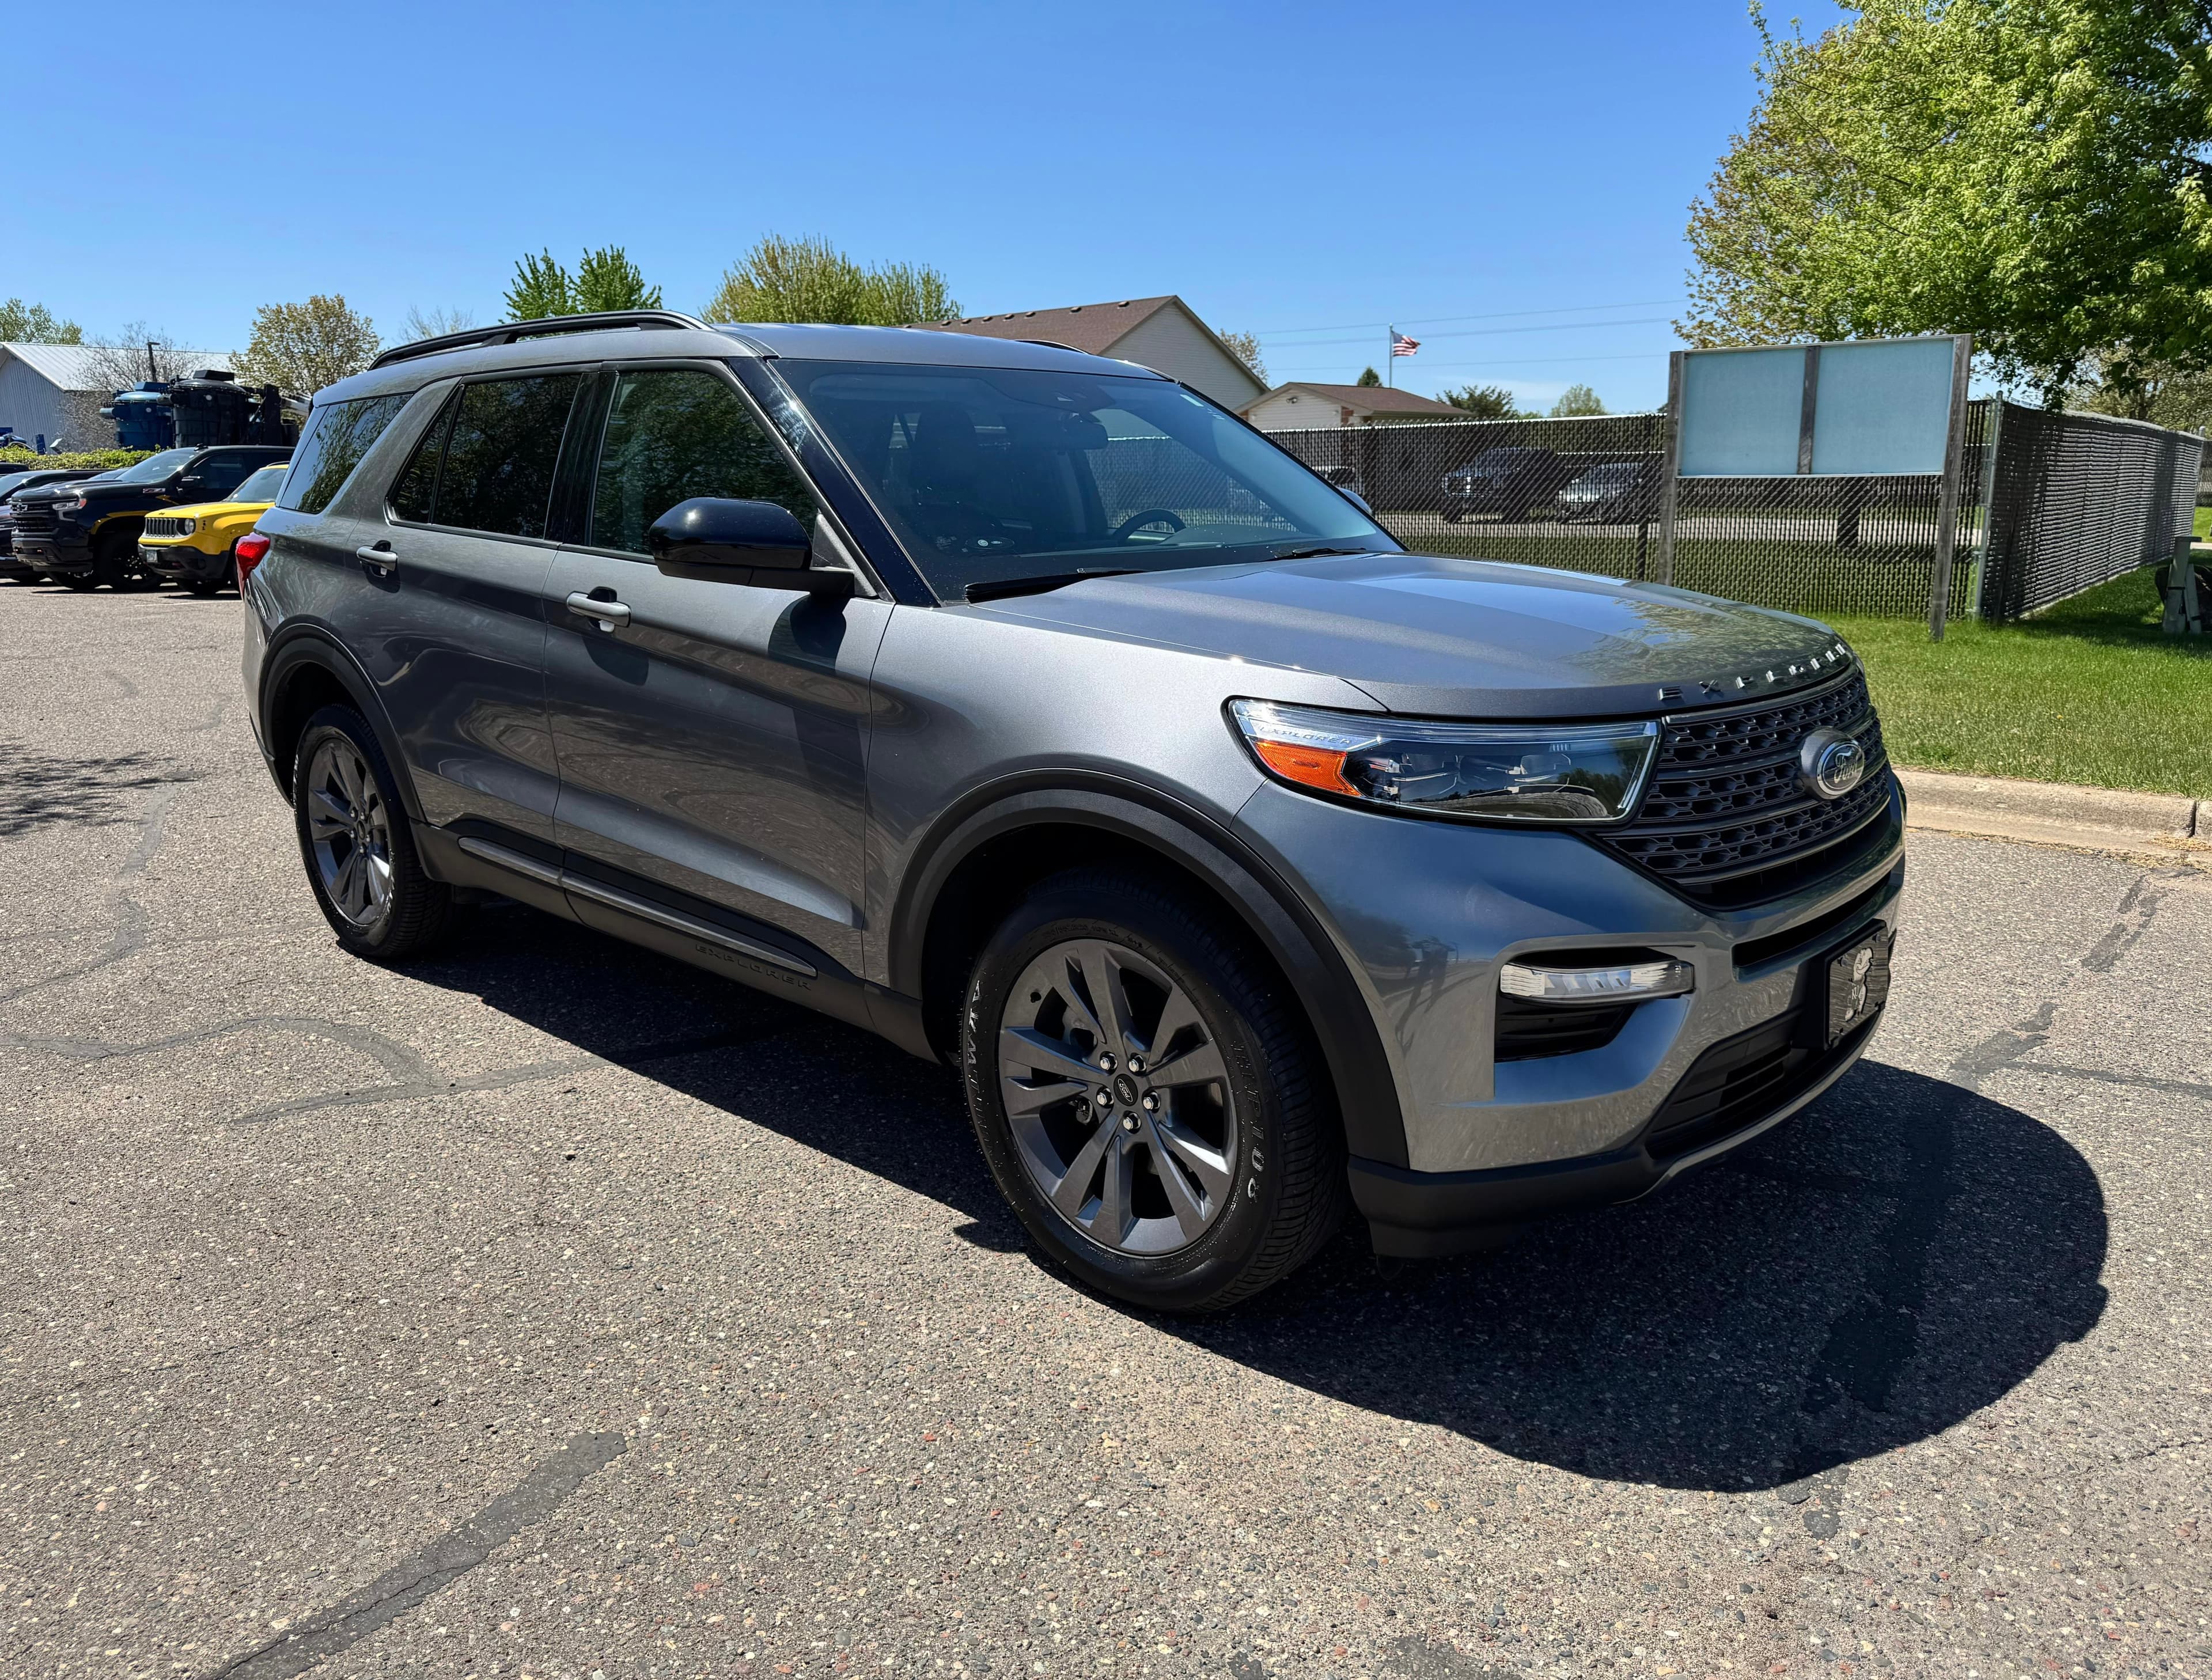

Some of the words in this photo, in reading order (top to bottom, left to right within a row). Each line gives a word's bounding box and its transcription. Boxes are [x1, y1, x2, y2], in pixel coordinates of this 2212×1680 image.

[1658, 643, 1846, 701] EXPLO
[1259, 726, 1351, 745] XPLORER
[1834, 748, 1862, 784] Ford
[695, 943, 812, 991] EXPLORER
